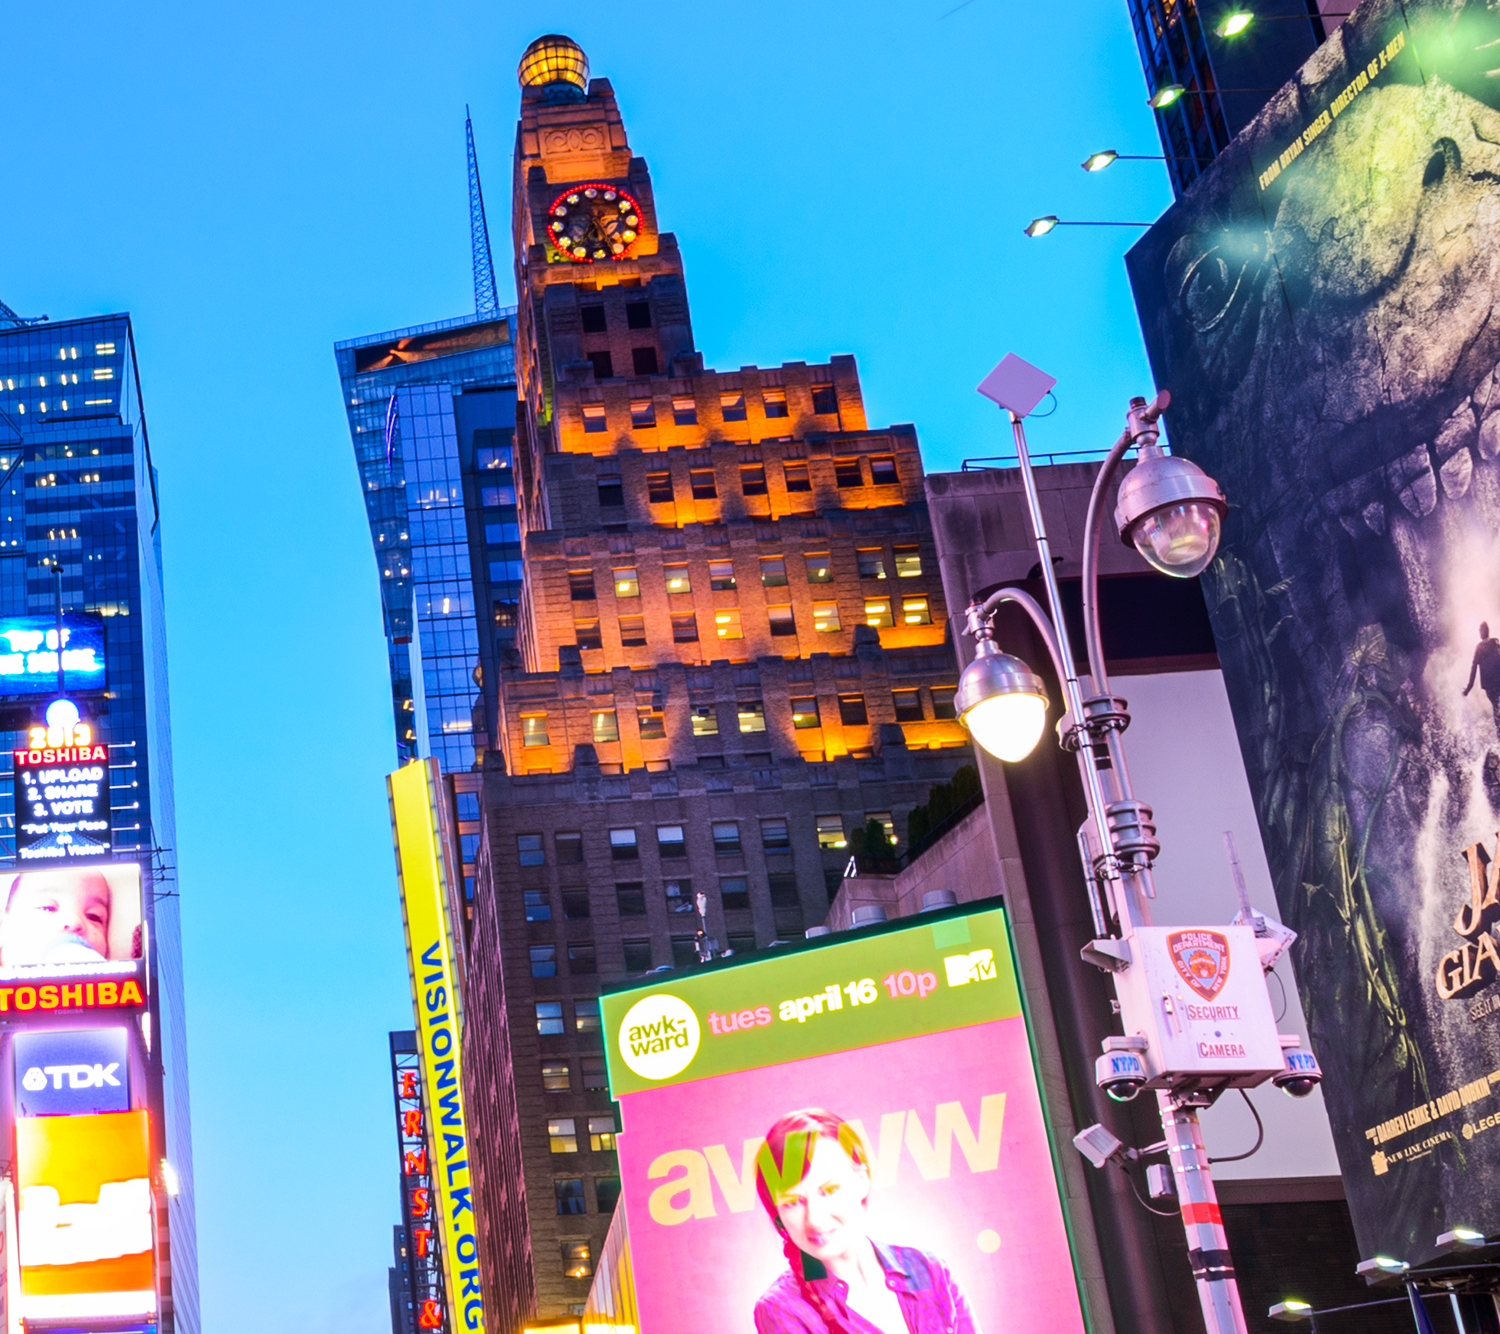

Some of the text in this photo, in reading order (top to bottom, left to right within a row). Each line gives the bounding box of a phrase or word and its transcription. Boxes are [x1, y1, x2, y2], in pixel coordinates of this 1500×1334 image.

[15, 746, 106, 765] TOSHIBA
[23, 767, 103, 784] 1. UPLOAD
[28, 784, 98, 800] 2. SHARE
[34, 801, 93, 816] 3. VOTE
[1181, 932, 1212, 942] POLICE
[1172, 940, 1226, 953] DEPARTMENT
[709, 1002, 772, 1035] tues
[779, 983, 843, 1023] april
[847, 978, 878, 1008] 16
[882, 969, 937, 1003] 10p
[1188, 1004, 1238, 1019] SECURITY
[628, 1016, 686, 1042] awk-
[630, 1030, 690, 1058] ward
[1200, 1042, 1246, 1057] CAMERA
[1112, 1056, 1140, 1072] NYPD
[1287, 1055, 1316, 1070] NYPD
[45, 1063, 120, 1089] TDK
[420, 940, 484, 1332] VISIONWALK.ORG
[403, 1071, 429, 1256] ERNST
